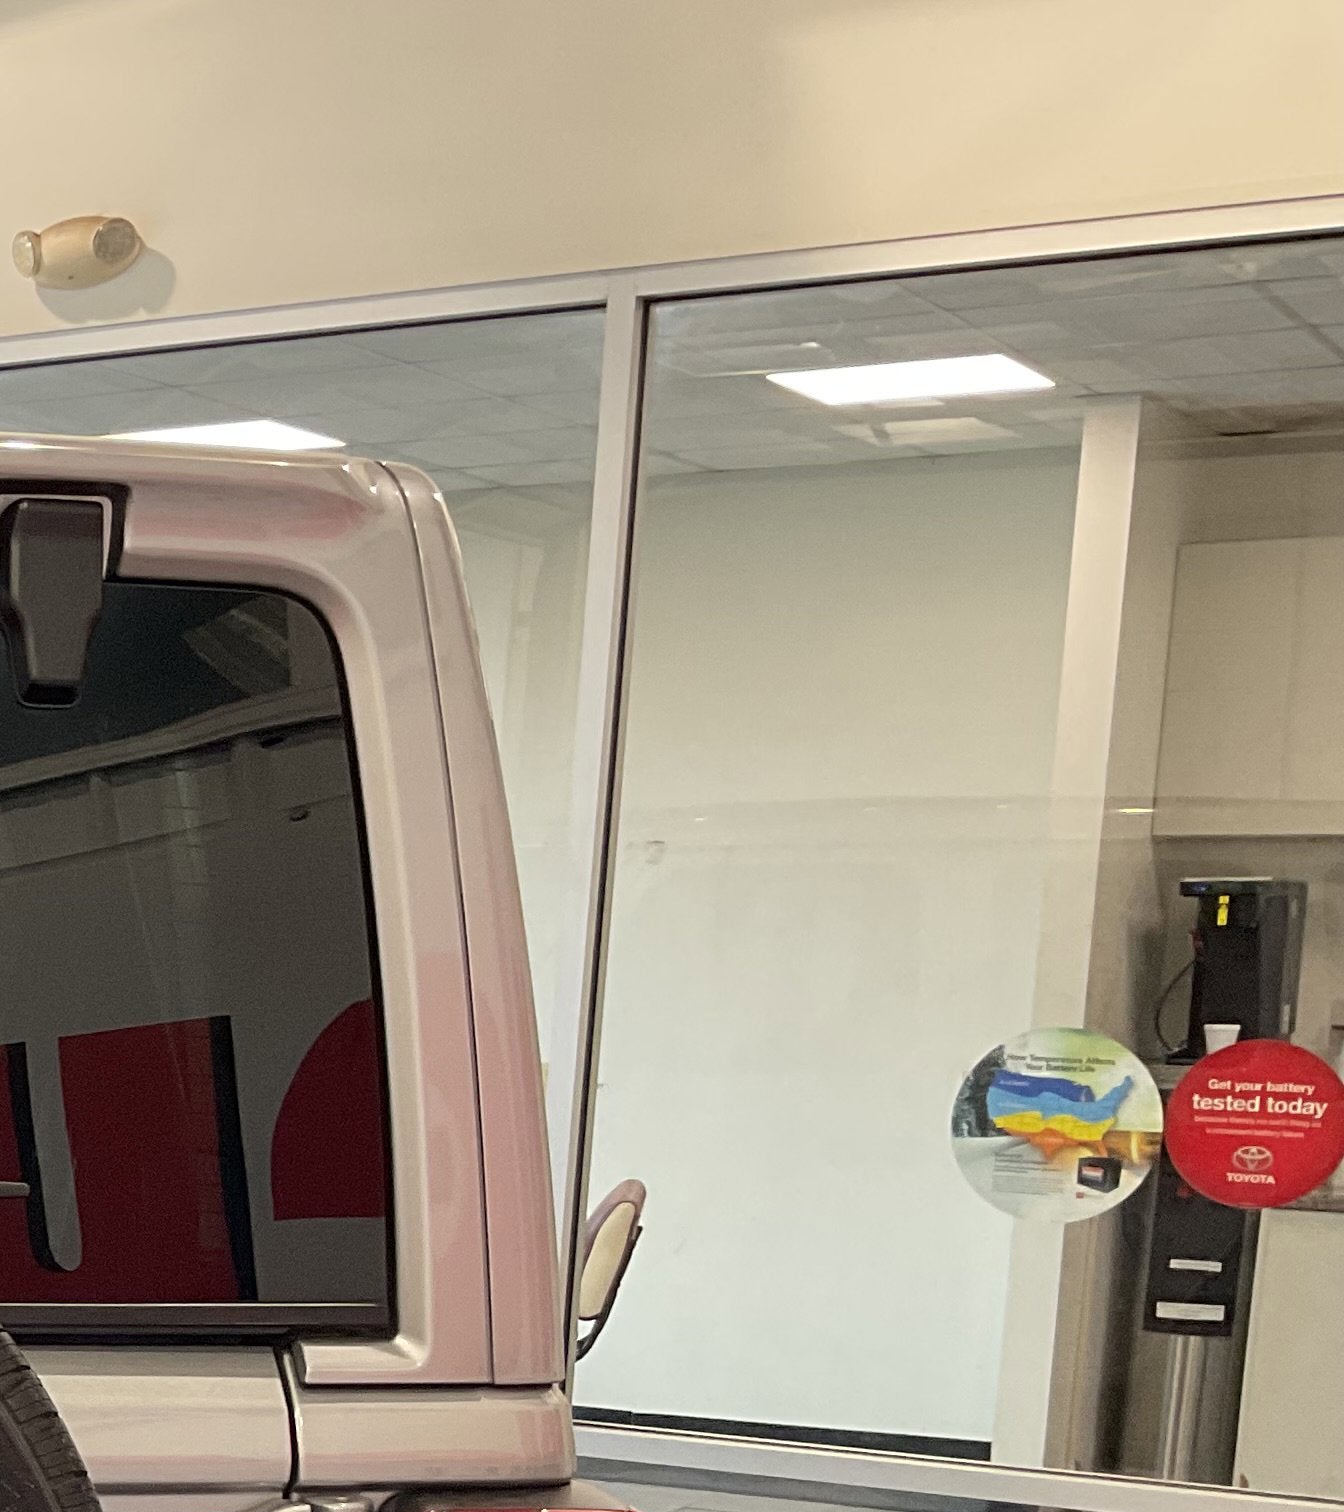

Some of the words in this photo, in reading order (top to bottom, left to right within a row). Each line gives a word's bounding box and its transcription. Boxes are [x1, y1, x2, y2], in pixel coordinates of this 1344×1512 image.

[1208, 1078, 1231, 1090] Get
[1234, 1082, 1264, 1093] your
[1266, 1081, 1315, 1096] battery
[1192, 1093, 1261, 1113] tested
[1267, 1097, 1328, 1119] today
[1226, 1172, 1276, 1184] TOYOTA
